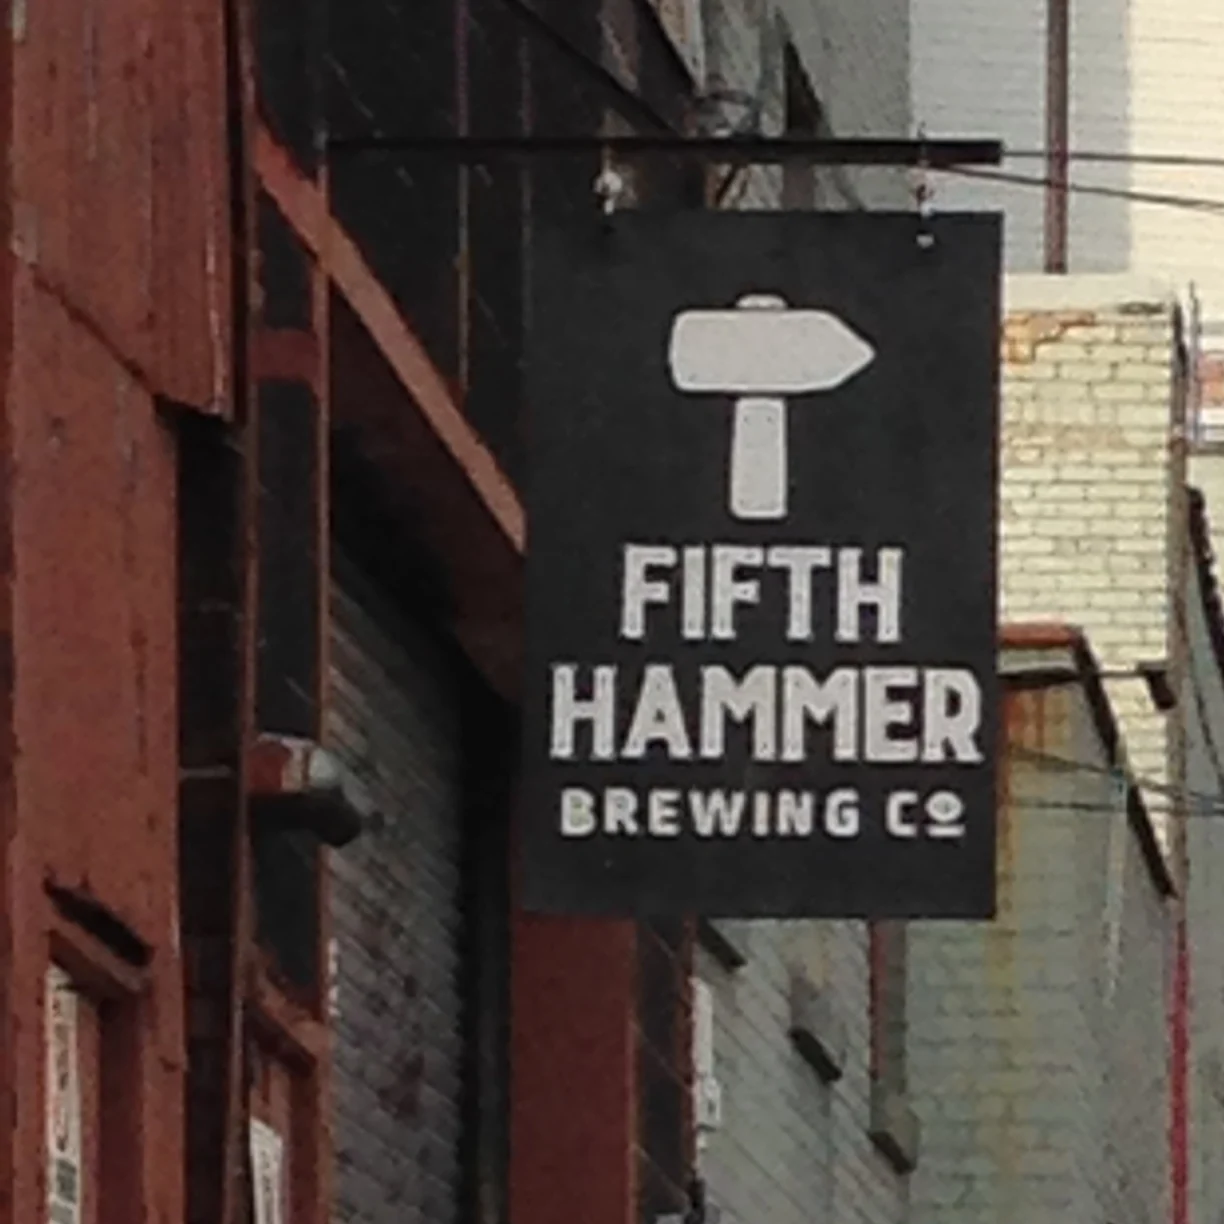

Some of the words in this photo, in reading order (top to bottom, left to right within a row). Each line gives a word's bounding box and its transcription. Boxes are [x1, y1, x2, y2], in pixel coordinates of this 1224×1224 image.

[621, 543, 902, 642] FIFTH
[550, 663, 983, 762] HAMMER
[560, 786, 860, 837] BREWING
